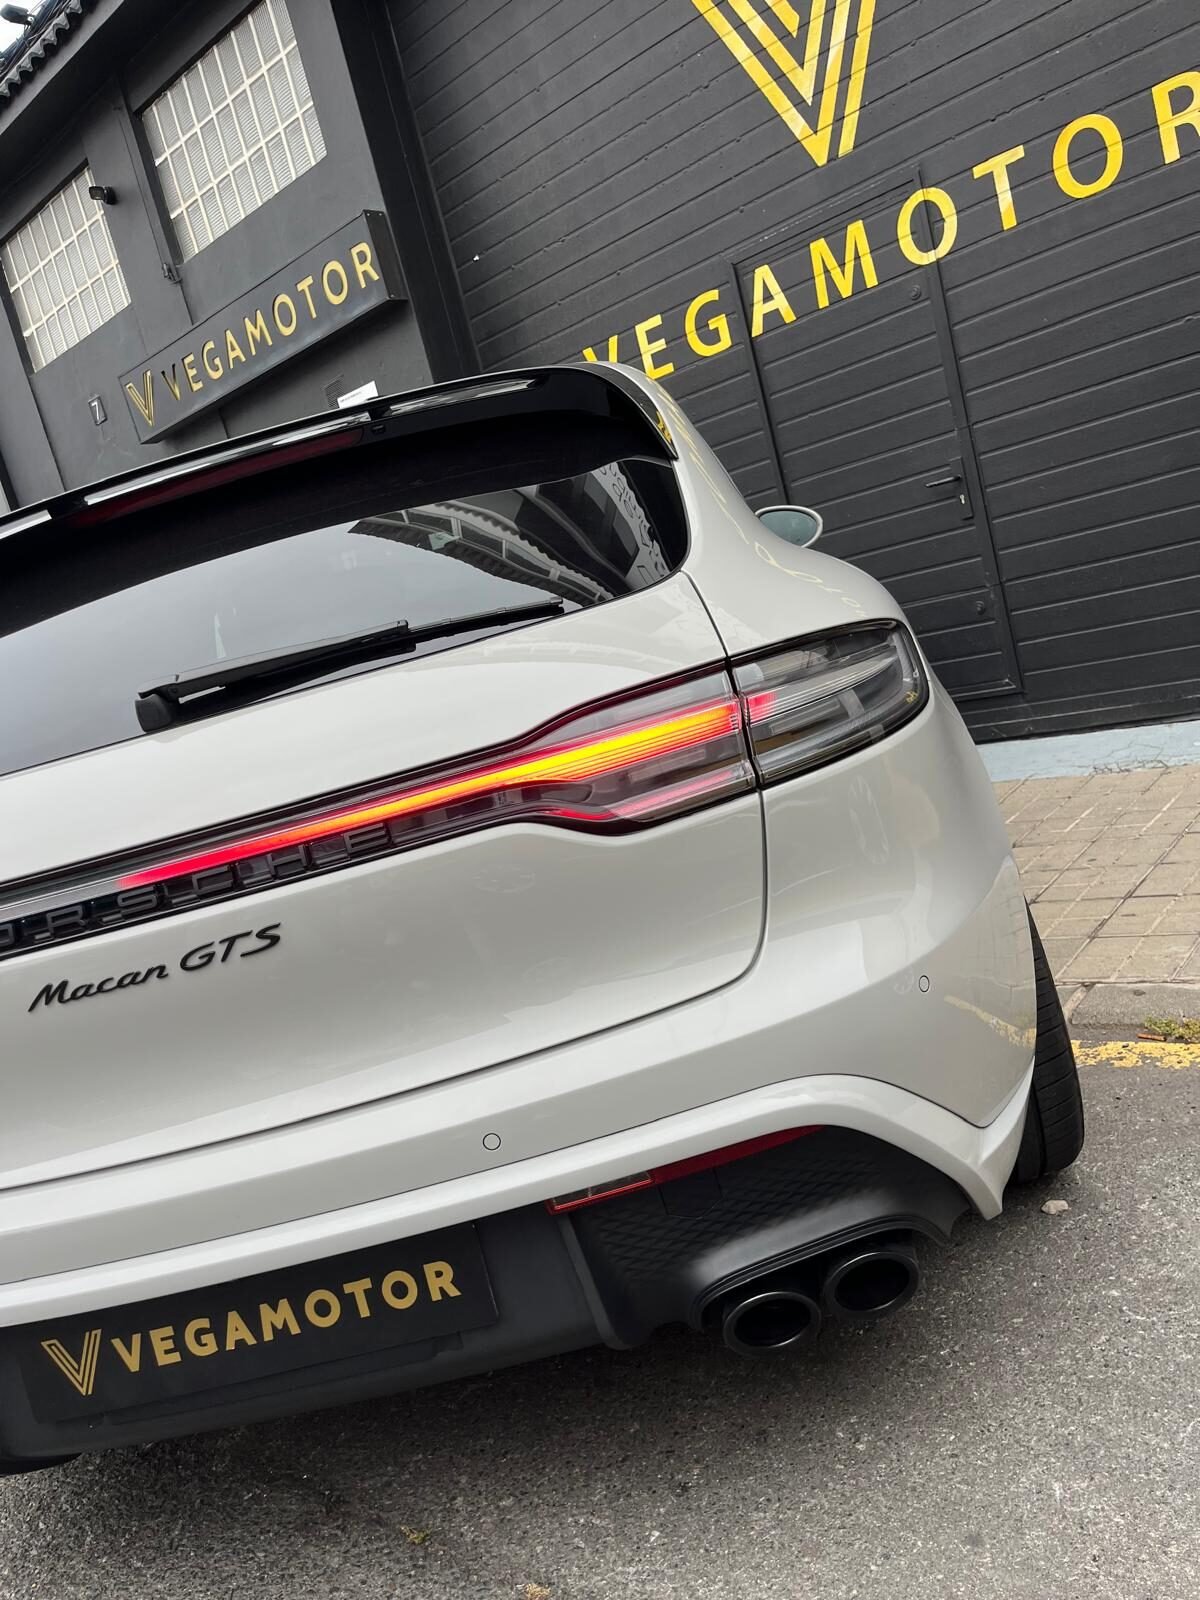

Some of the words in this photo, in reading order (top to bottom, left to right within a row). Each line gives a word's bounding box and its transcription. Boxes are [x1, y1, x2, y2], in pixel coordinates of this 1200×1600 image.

[161, 241, 380, 401] VEGAMOTOR
[28, 963, 169, 1013] Macan
[179, 922, 282, 972] GTS
[111, 1260, 462, 1373] VEGAMOTOR
